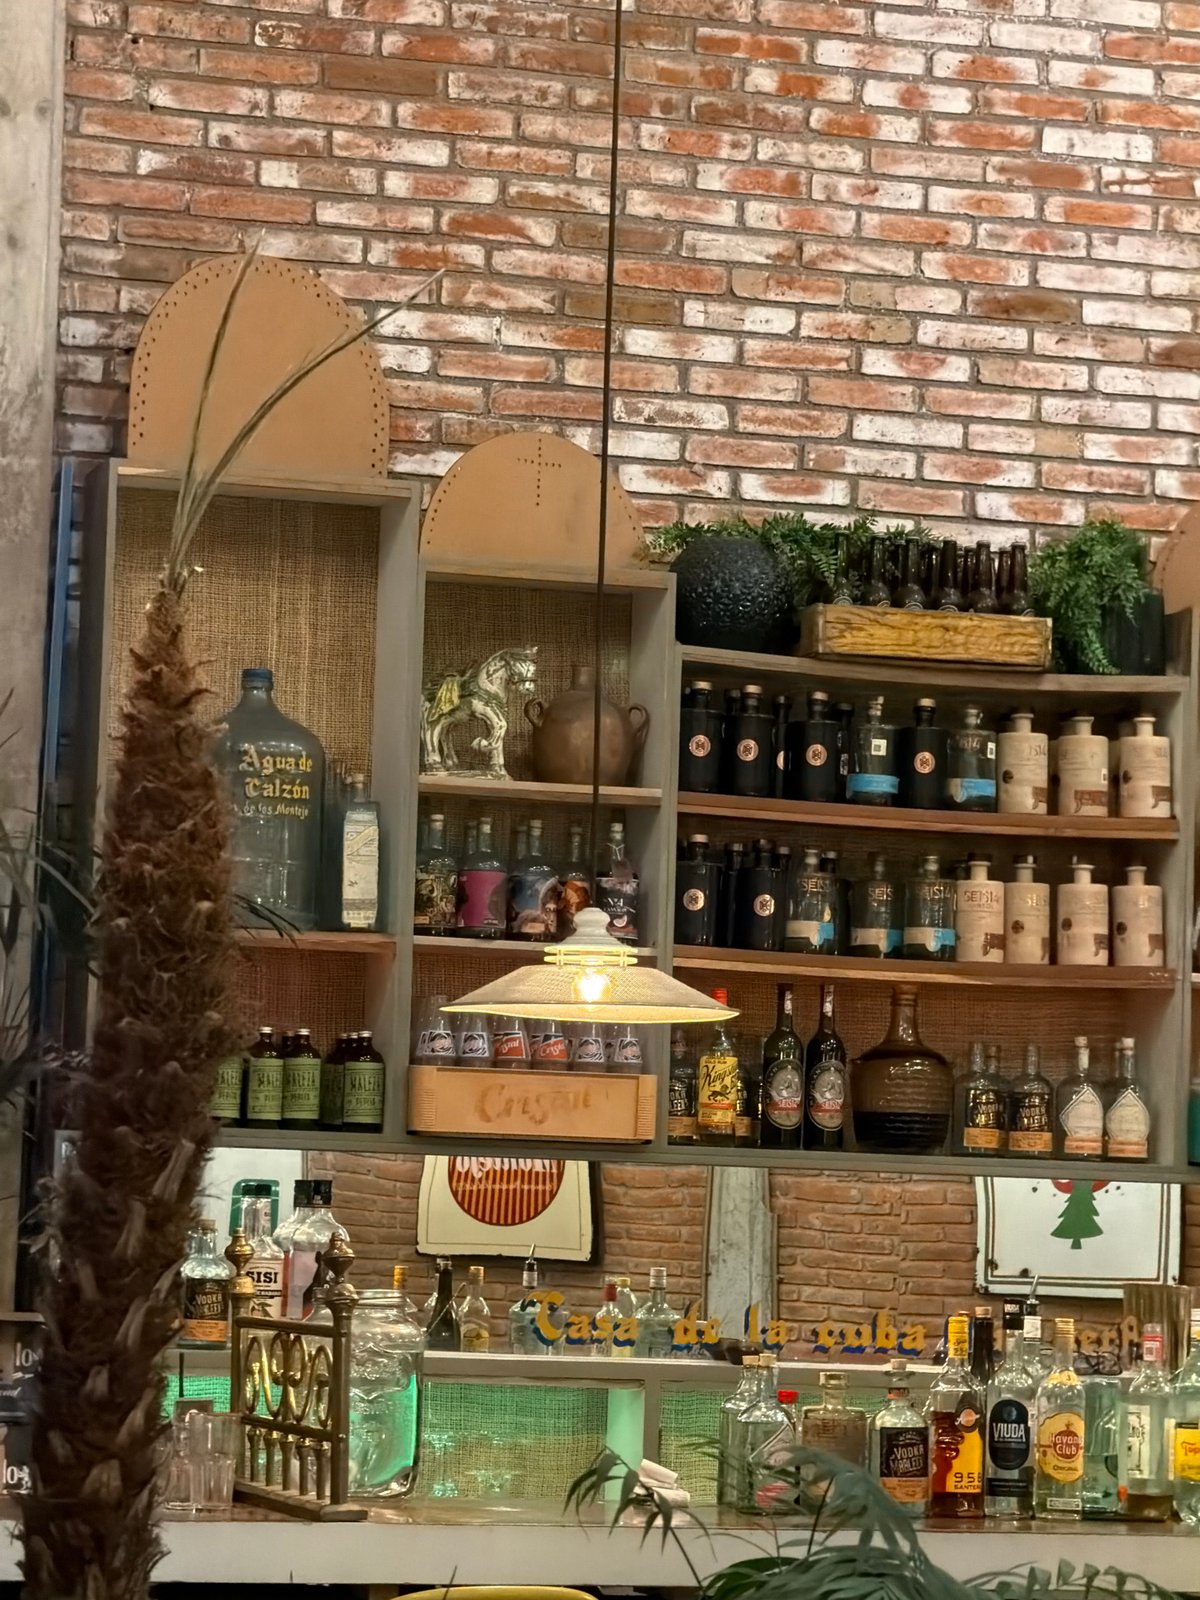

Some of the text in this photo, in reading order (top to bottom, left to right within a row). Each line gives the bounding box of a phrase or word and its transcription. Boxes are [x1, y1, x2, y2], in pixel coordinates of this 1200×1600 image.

[238, 744, 313, 775] Agua de
[245, 777, 310, 799] Calzón
[993, 1422, 1027, 1442] VIUDA
[893, 1444, 925, 1461] VODKA
[1056, 1443, 1078, 1455] Club
